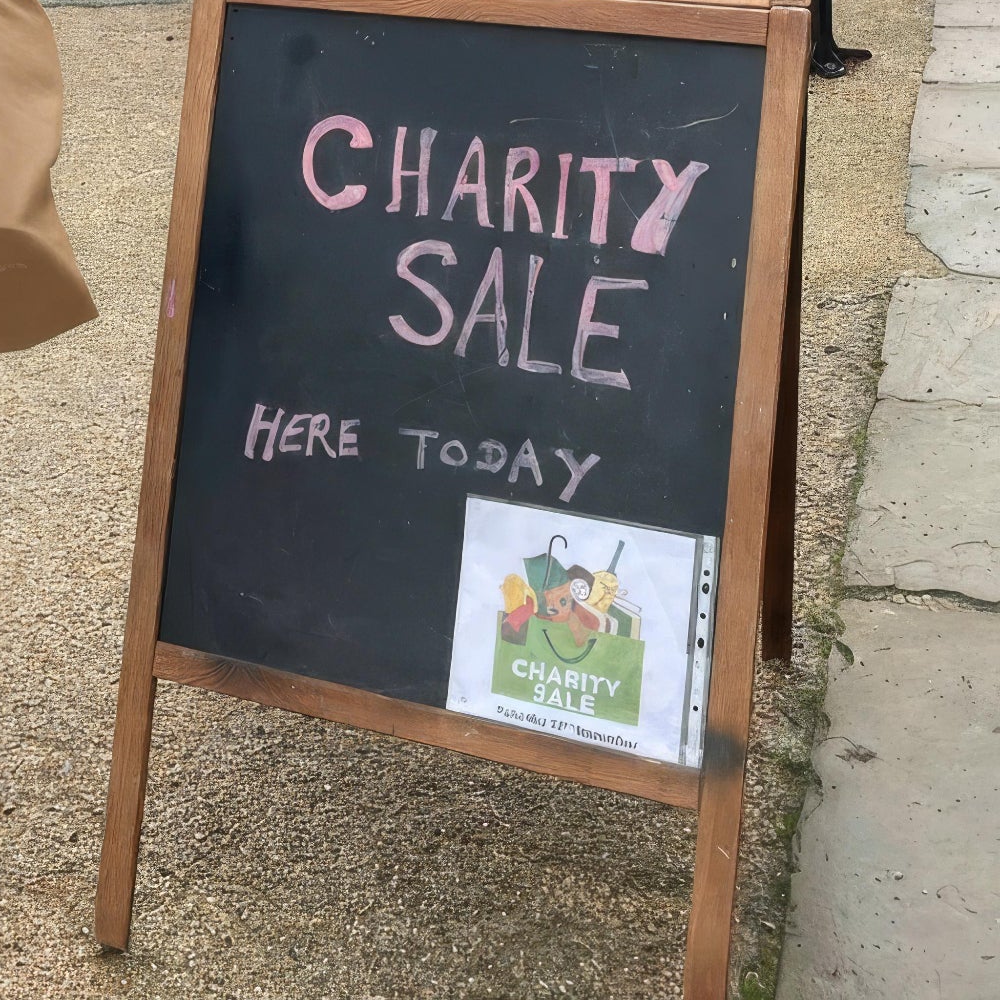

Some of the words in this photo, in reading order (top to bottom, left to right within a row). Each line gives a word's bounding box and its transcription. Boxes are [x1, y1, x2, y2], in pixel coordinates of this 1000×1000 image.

[302, 114, 710, 257] CHARITY
[388, 239, 649, 390] SALE
[244, 403, 360, 463] HERE
[398, 427, 602, 503] TODAY
[511, 658, 621, 697] CHARITY
